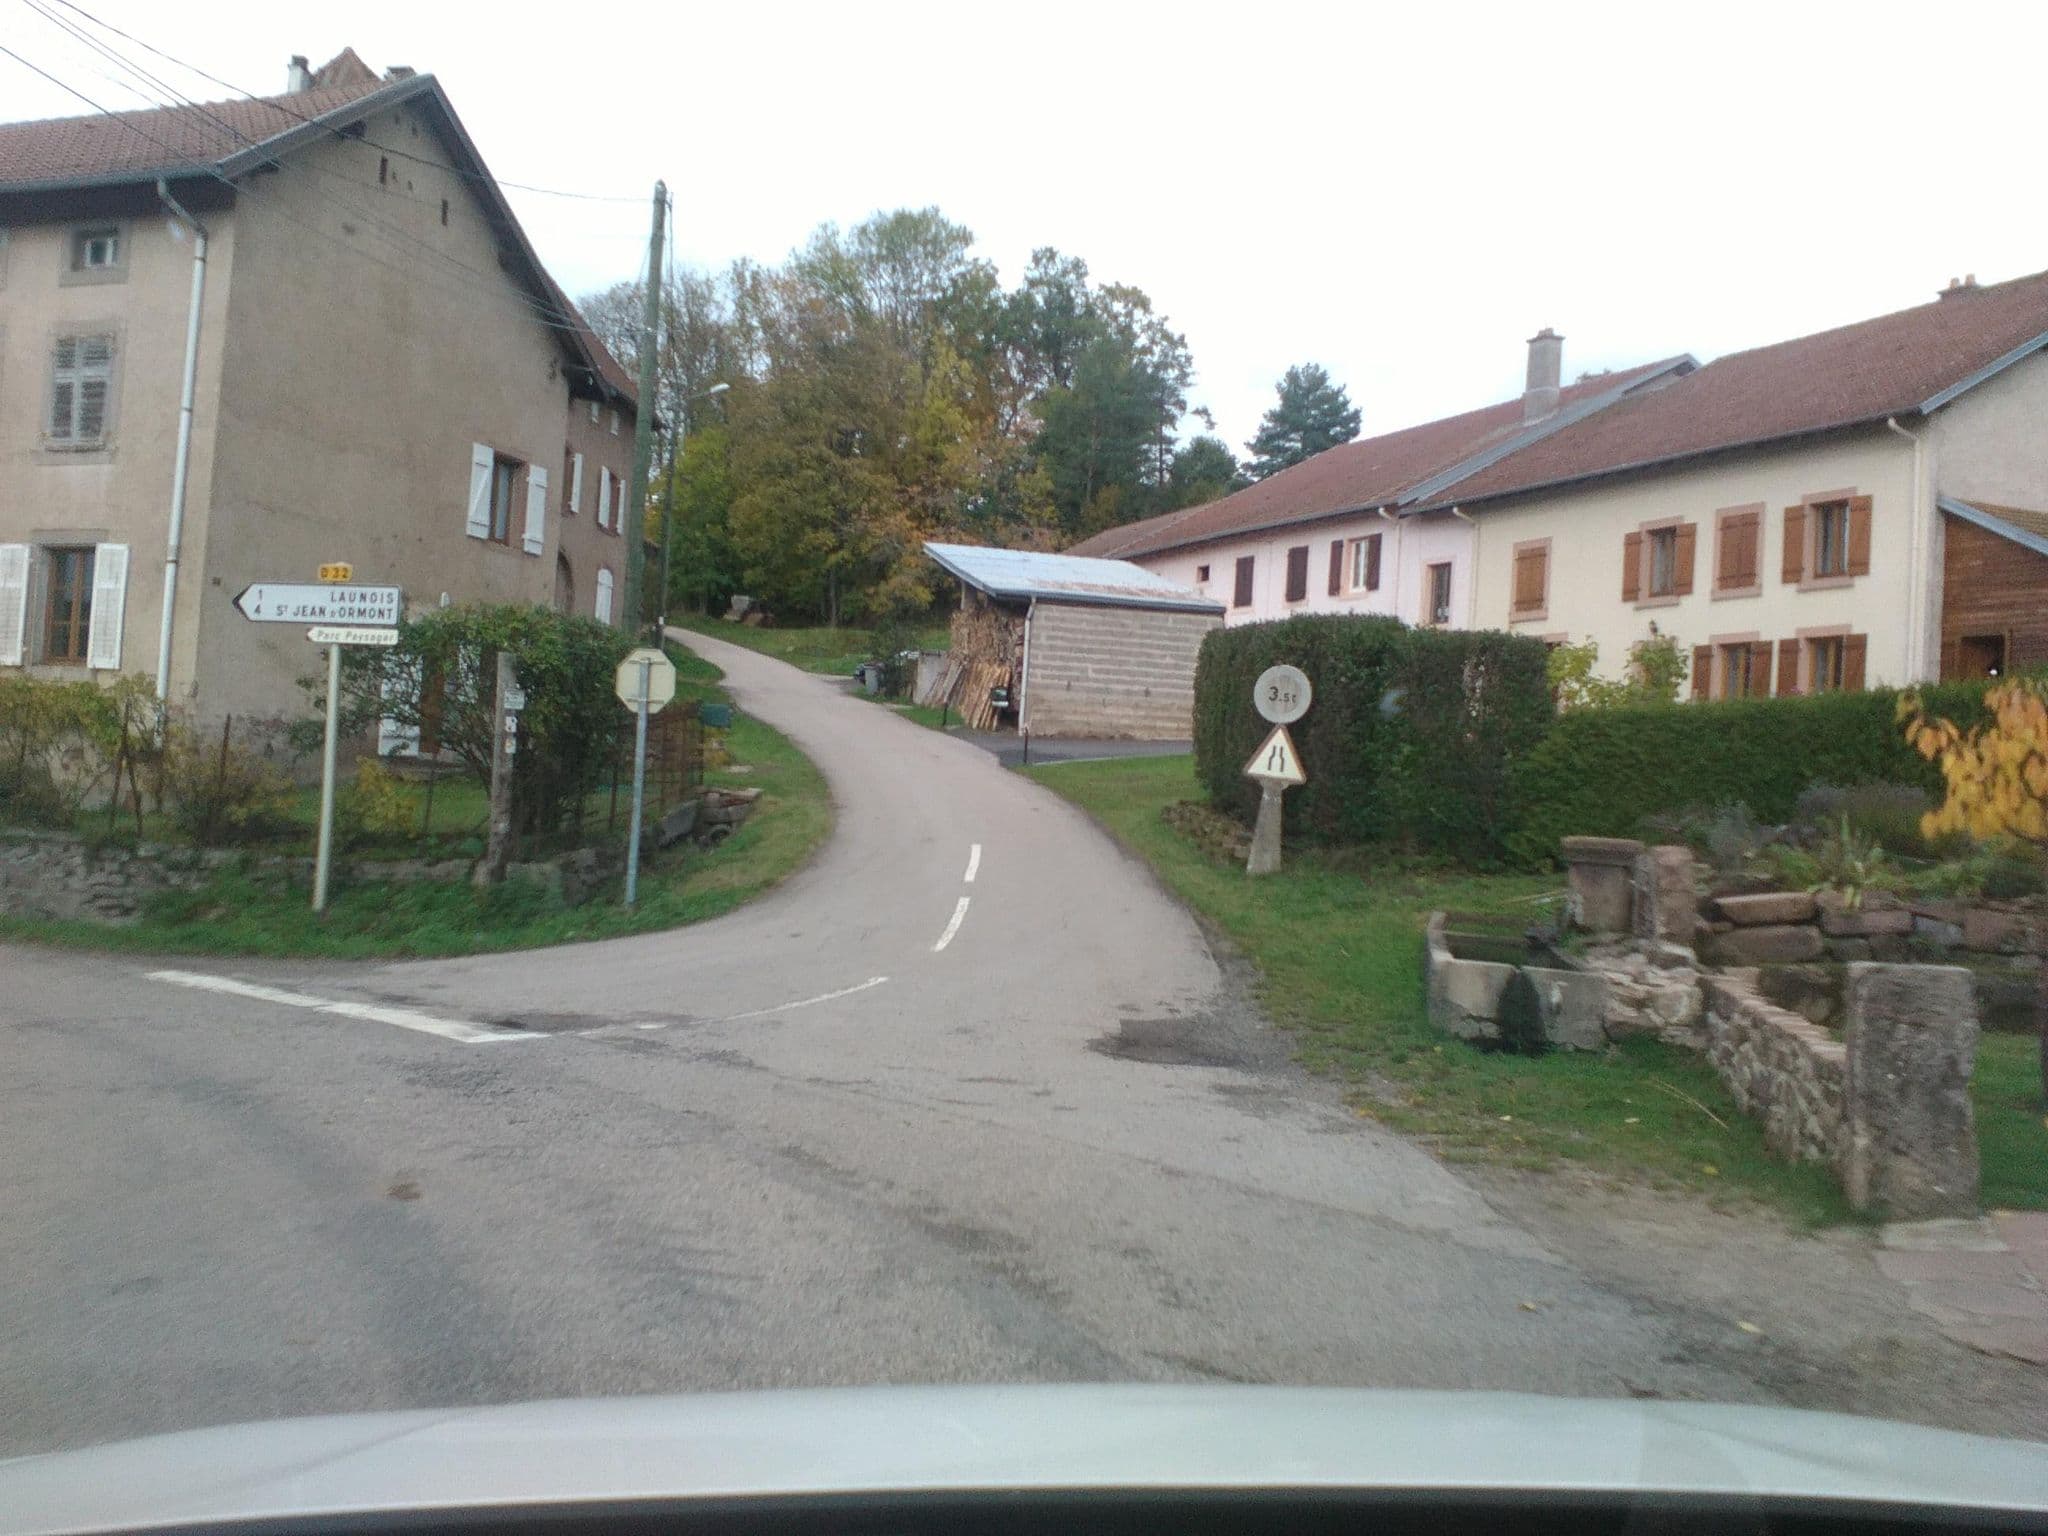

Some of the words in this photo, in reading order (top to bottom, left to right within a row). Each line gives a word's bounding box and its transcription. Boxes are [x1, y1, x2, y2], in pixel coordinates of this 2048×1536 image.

[331, 592, 394, 604] LAUNOIS
[254, 604, 262, 615] 4
[293, 605, 326, 617] JEAN
[317, 630, 340, 641] Parc
[346, 631, 395, 645] Paysager
